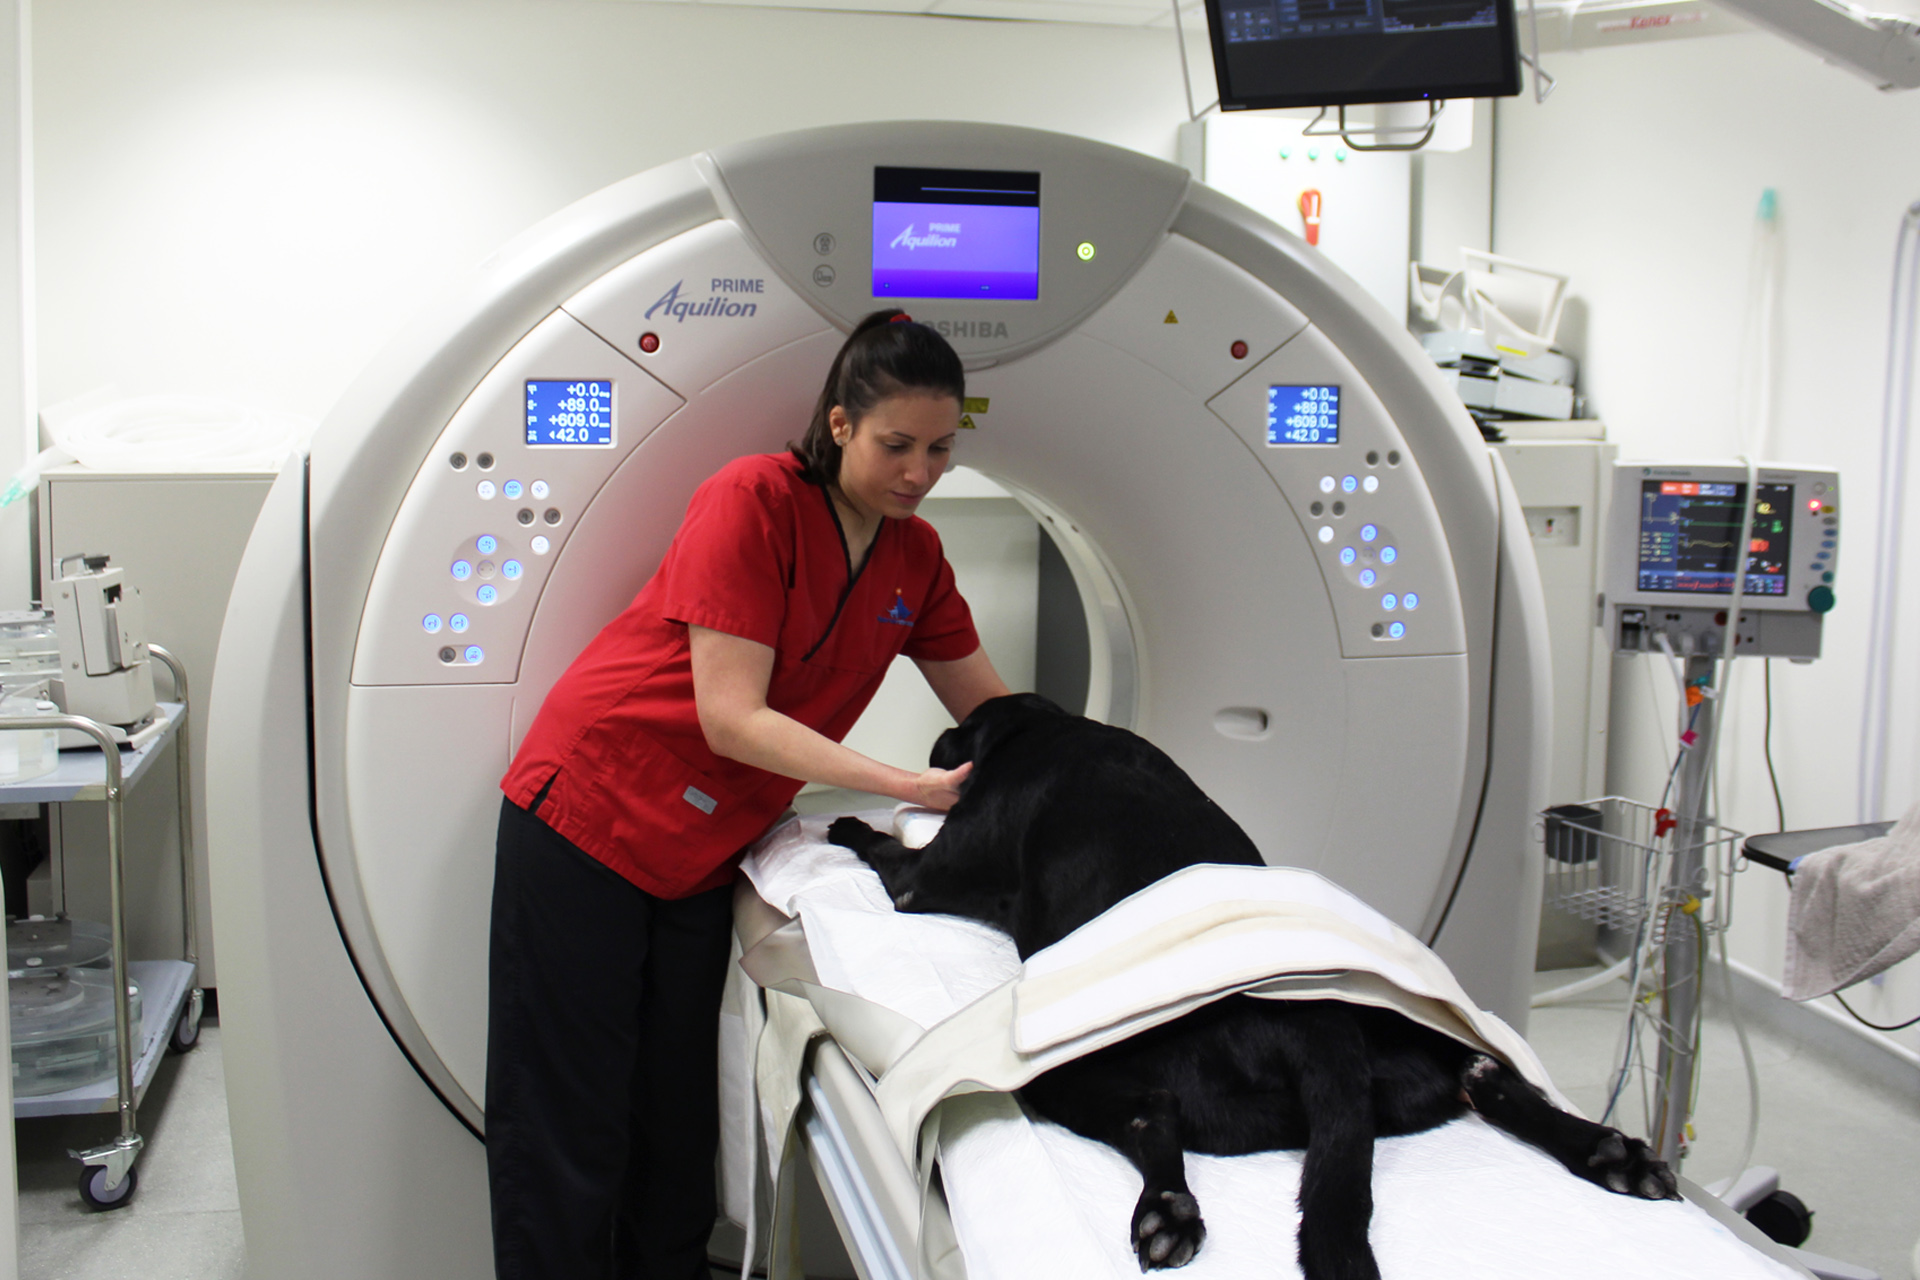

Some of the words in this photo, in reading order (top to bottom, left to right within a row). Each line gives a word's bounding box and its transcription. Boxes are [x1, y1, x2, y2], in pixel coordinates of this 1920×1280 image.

[929, 222, 961, 233] PRIME
[890, 223, 957, 251] Aquilion
[711, 279, 765, 293] PRIME
[644, 279, 757, 323] Aquilion
[917, 321, 1009, 338] SHIBA
[567, 382, 599, 397] +0.0
[558, 398, 599, 412] +89.0
[548, 413, 599, 427] +609.0
[556, 428, 589, 442] 42.0
